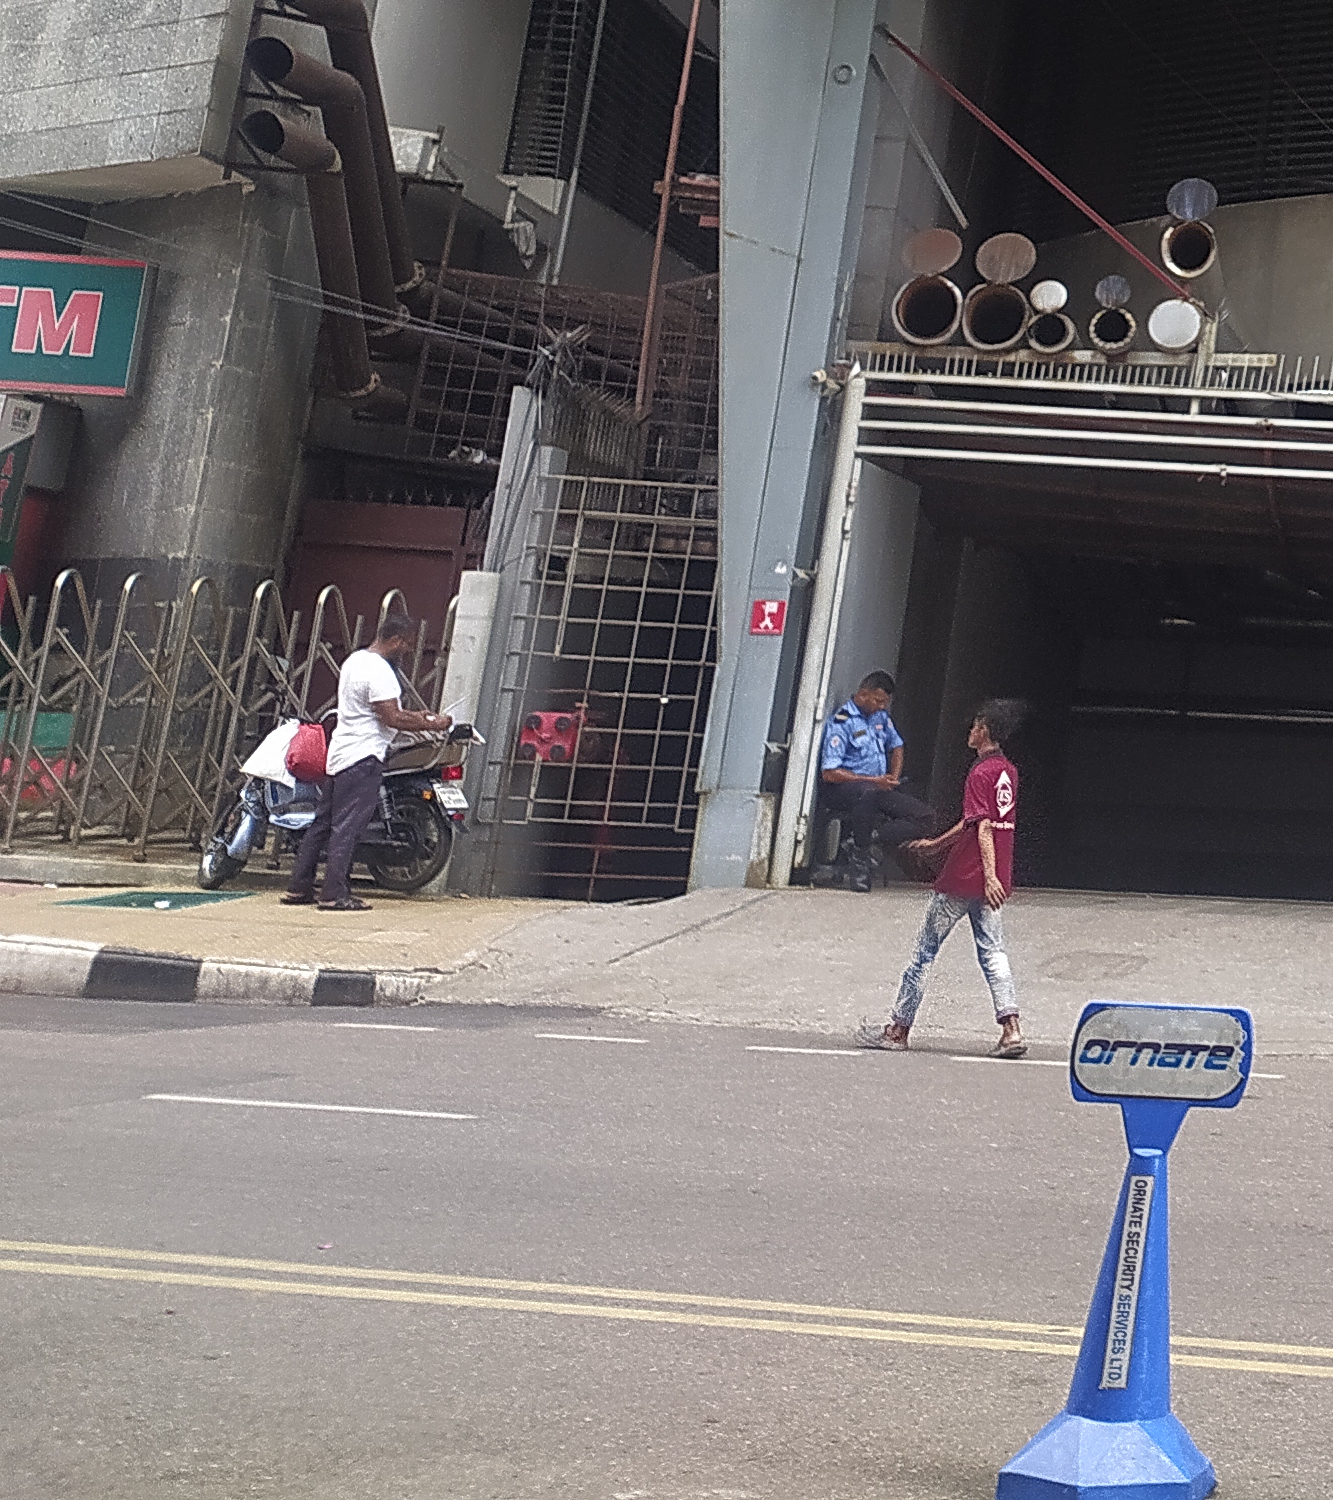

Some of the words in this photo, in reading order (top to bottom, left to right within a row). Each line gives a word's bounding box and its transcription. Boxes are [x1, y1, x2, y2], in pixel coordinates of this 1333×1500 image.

[1128, 1178, 1149, 1229] ORNATE
[1118, 1230, 1141, 1293] SECURITY
[1110, 1293, 1132, 1356] SERVICES
